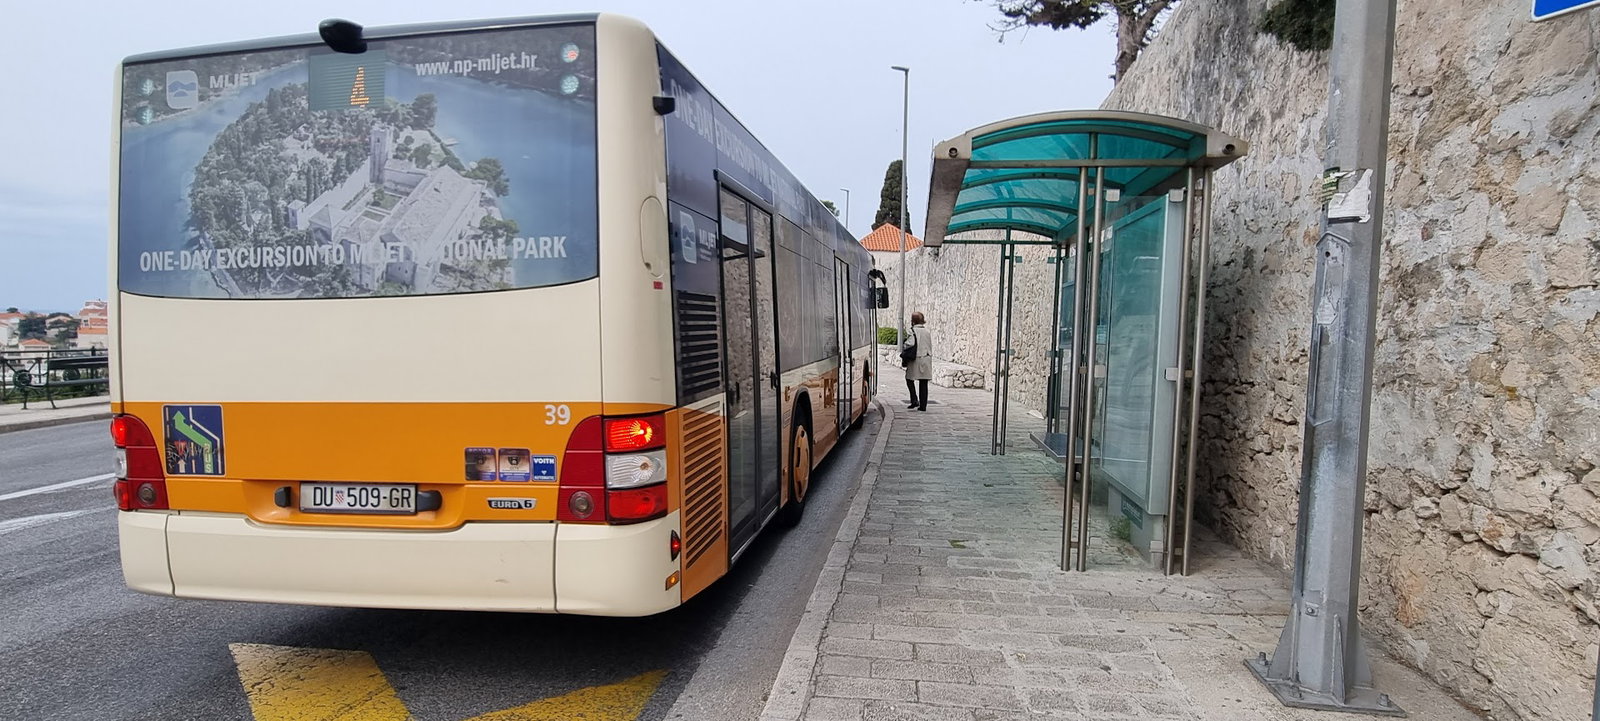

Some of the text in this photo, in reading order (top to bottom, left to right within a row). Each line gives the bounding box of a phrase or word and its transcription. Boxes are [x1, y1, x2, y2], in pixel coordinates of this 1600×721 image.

[415, 51, 538, 77] www.np-mljet.hr
[209, 72, 258, 89] MLJET
[350, 66, 370, 109] 4
[140, 250, 212, 272] ONE-DAY
[216, 244, 317, 269] EXCURSION
[319, 244, 344, 265] TO
[350, 241, 408, 264] MET
[512, 235, 567, 259] PARK
[544, 404, 571, 425] 39
[313, 486, 412, 508] DU 509-GR
[524, 500, 532, 508] 6
